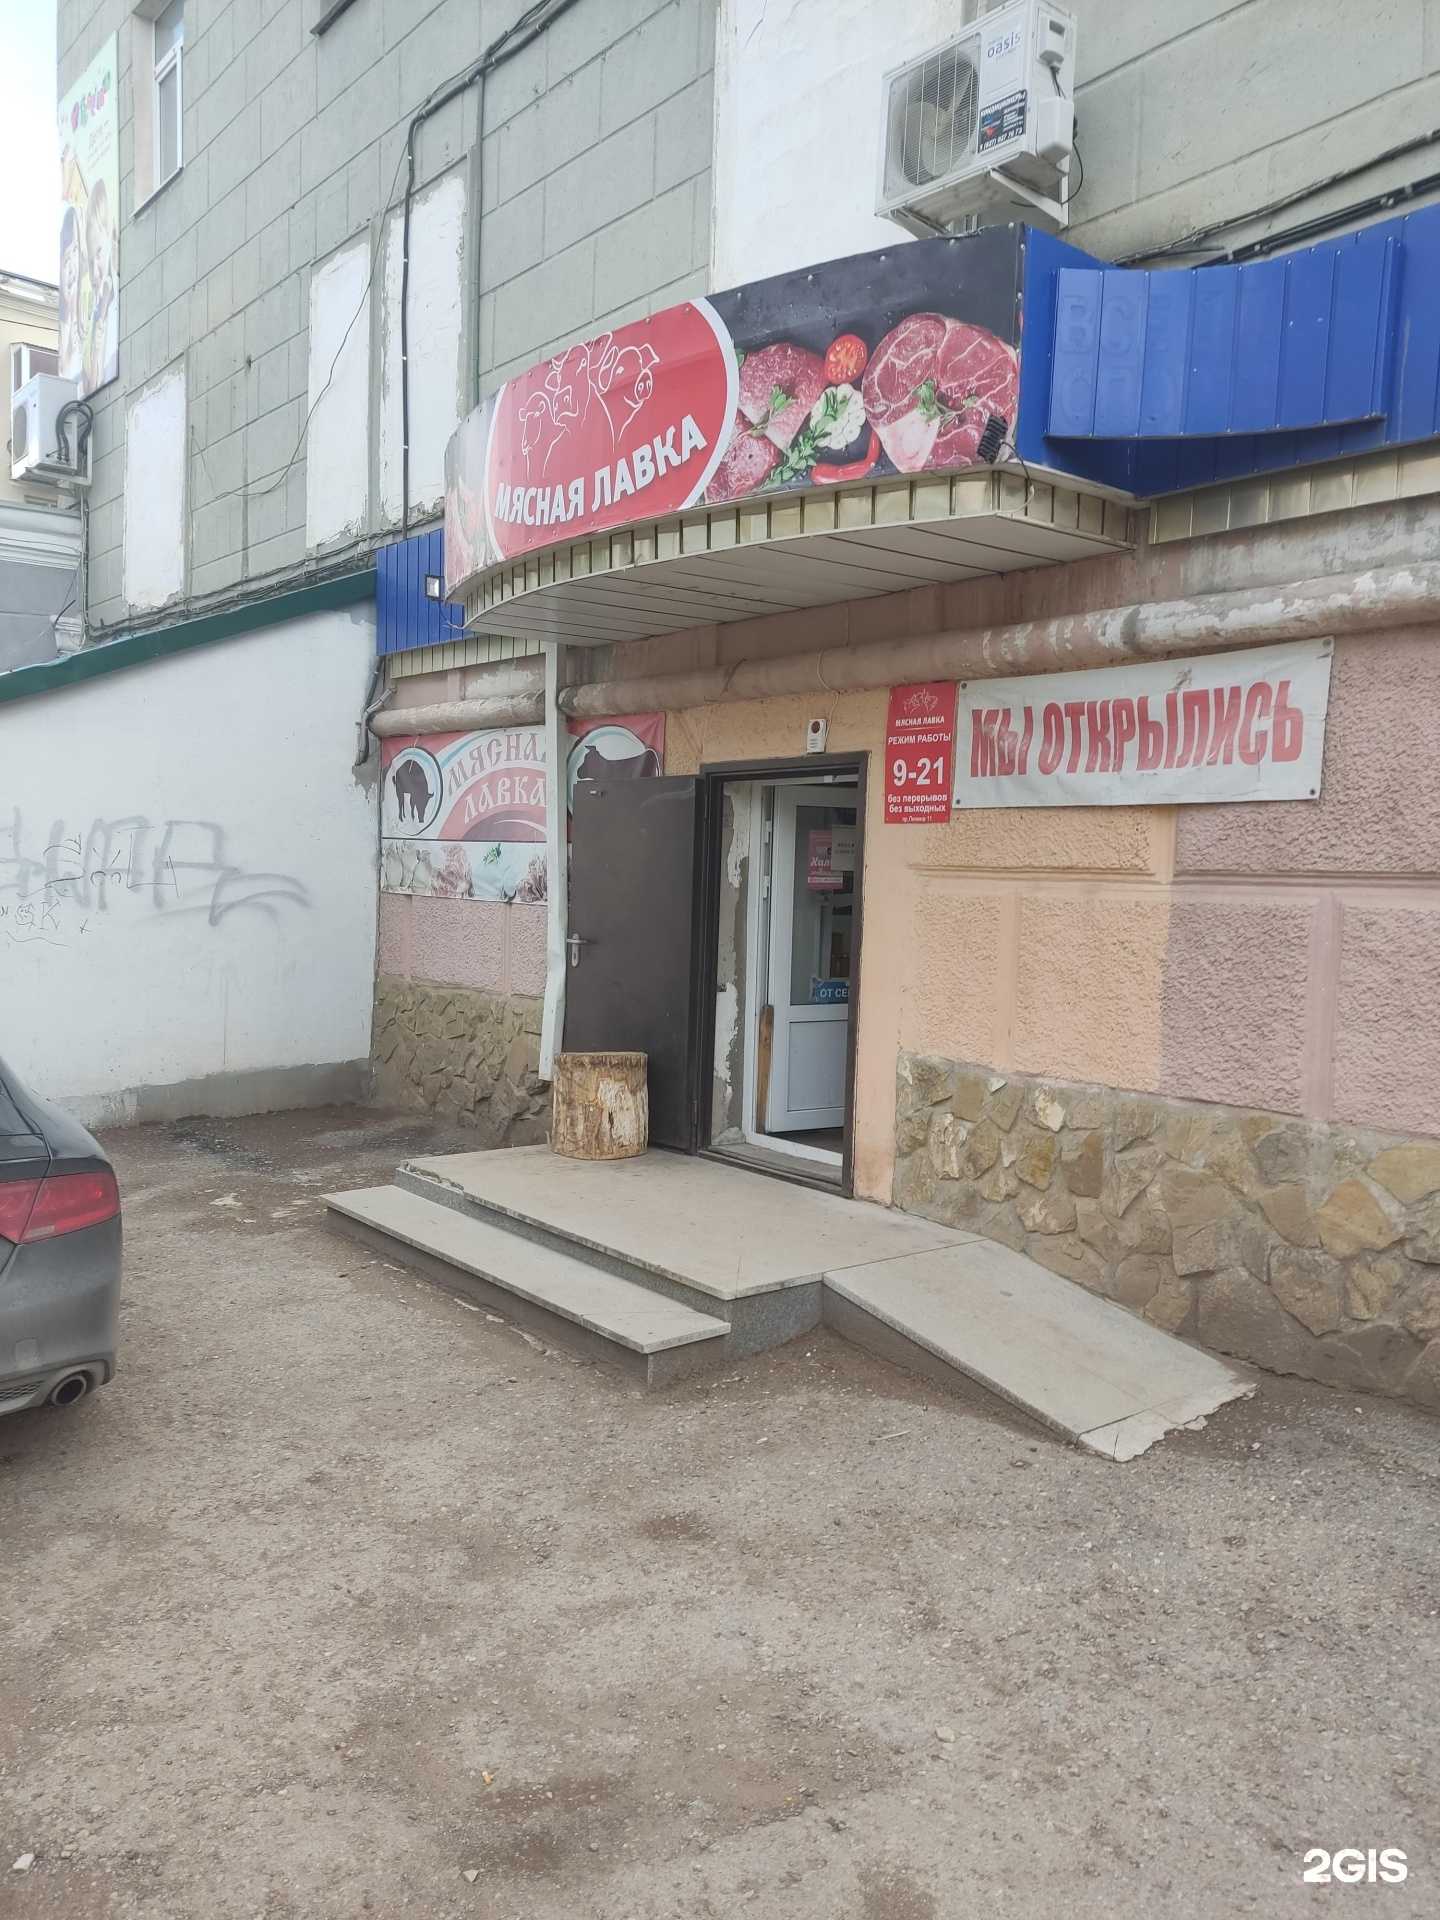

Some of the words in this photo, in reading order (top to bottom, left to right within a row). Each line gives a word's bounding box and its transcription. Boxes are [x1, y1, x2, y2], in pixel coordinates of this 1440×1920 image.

[987, 31, 1021, 58] oasis
[495, 477, 585, 526] МЯСНАЯ
[592, 414, 708, 512] ЛАВКА
[923, 715, 945, 725] ЛАВКА
[970, 706, 1034, 777] МЫ
[1038, 680, 1304, 776] ОТКРЫЛИСЬ
[888, 735, 916, 745] РЕЖИМ
[917, 732, 951, 744] РАБОТЫ
[893, 757, 944, 786] 9-21
[464, 775, 547, 825] ЛАВКА
[887, 794, 901, 803] без
[902, 794, 948, 805] перерывов
[889, 803, 902, 813] без
[903, 804, 946, 814] выходных
[820, 987, 833, 998] ОТ
[835, 987, 848, 998] СЕ
